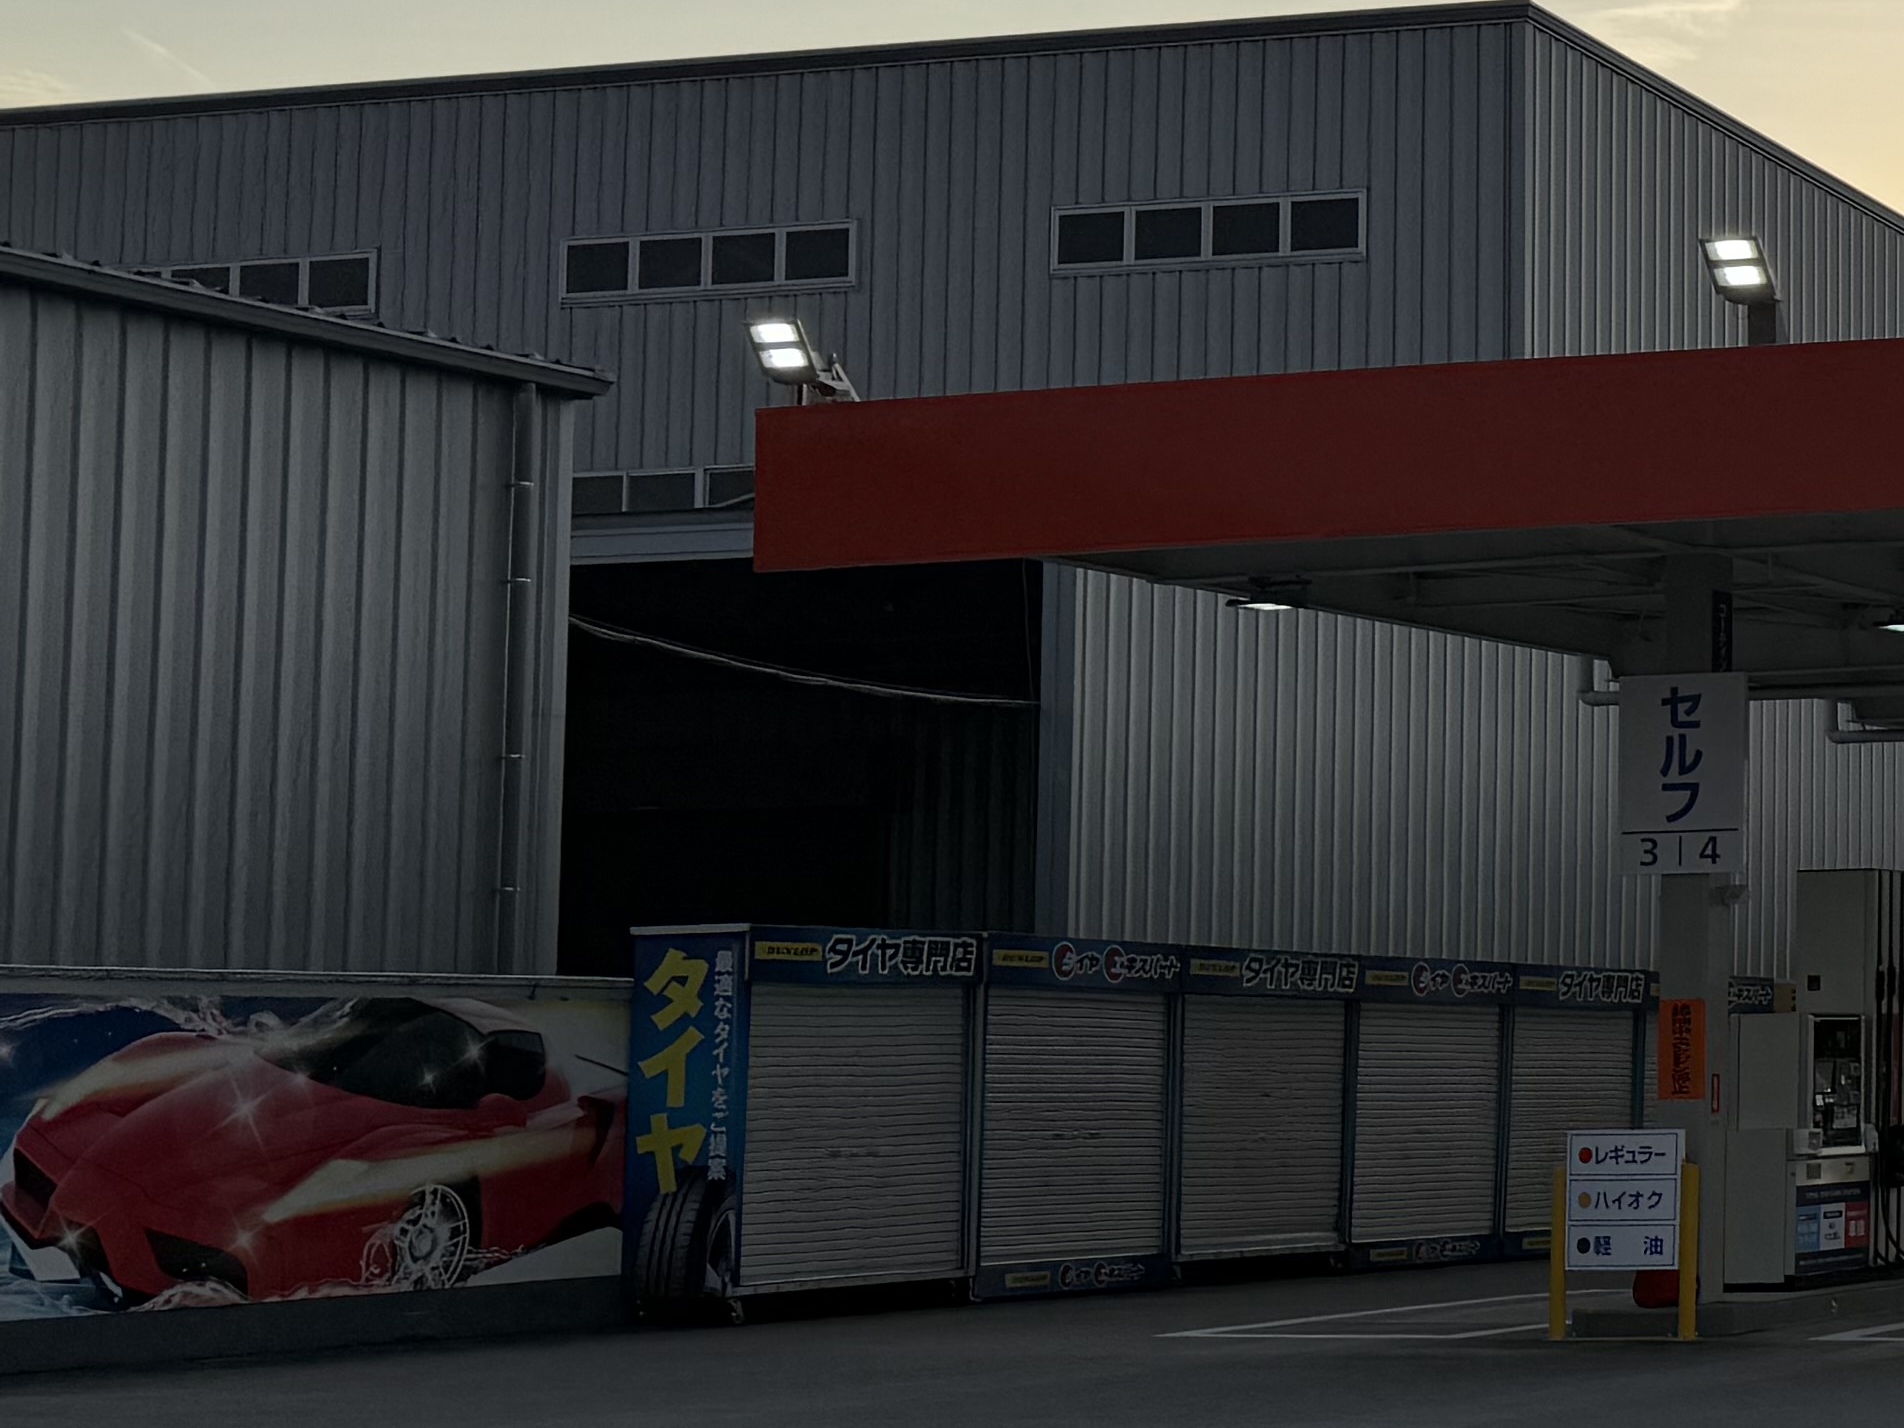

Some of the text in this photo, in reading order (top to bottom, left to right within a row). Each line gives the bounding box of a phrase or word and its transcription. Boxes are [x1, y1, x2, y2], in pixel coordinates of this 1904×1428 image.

[1660, 686, 1703, 823] セルフ
[1640, 836, 1721, 866] 3 4
[826, 933, 978, 978] タイヤ専門店
[1241, 955, 1360, 993] タイヤ専門店
[1558, 971, 1645, 1004] タイヤ専門店
[635, 947, 710, 1195] タイヤ
[1595, 1145, 1666, 1165] レギュラー
[1595, 1190, 1663, 1209] ハイオク
[1593, 1235, 1664, 1256] 軽 油
